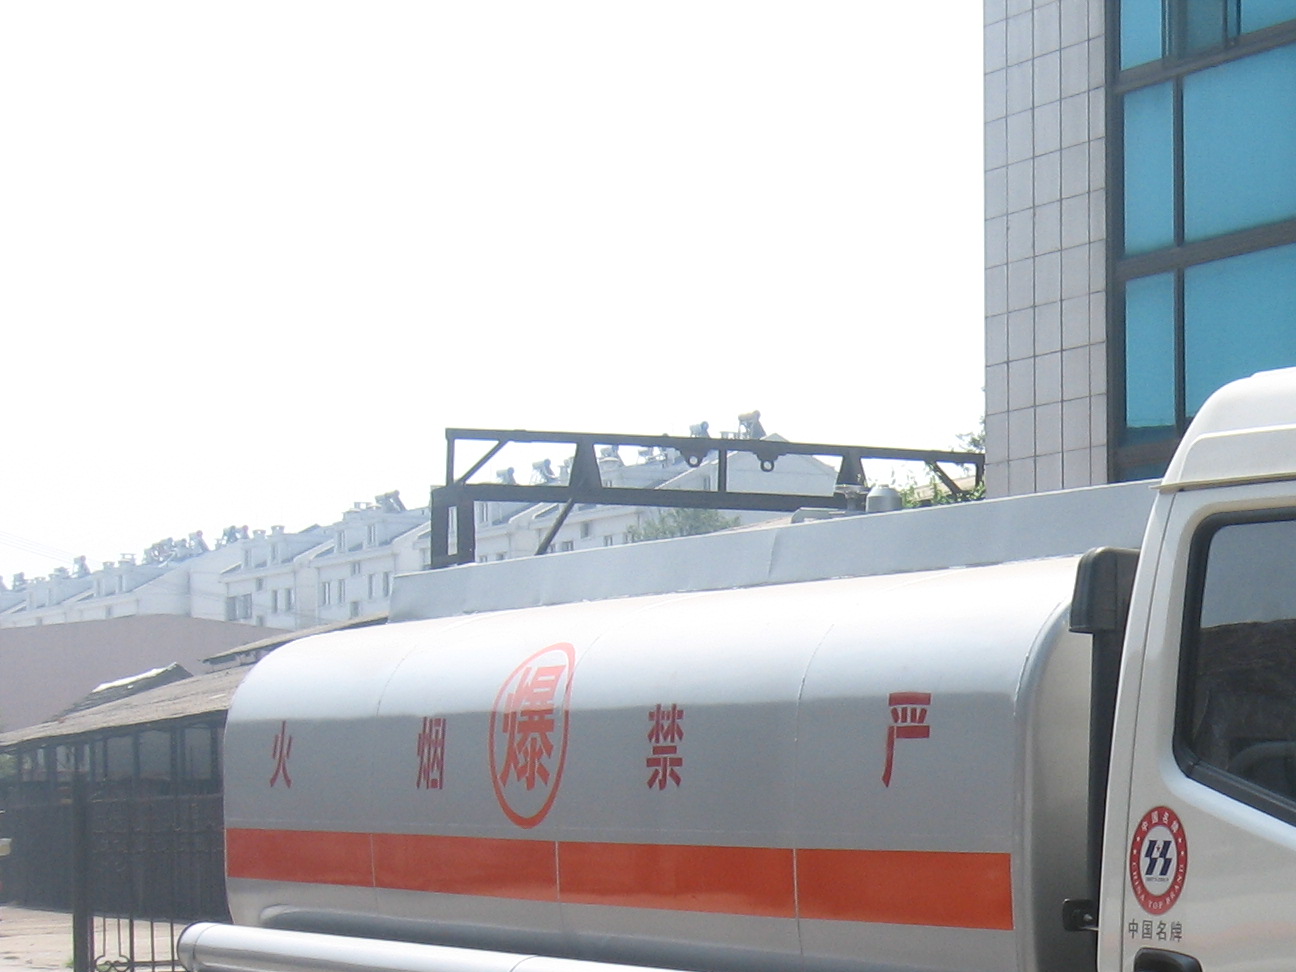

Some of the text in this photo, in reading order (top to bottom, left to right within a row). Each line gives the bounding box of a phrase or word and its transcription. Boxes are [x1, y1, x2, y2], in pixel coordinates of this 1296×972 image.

[269, 691, 932, 791] 火 烟 禁 严
[500, 664, 566, 791] 爆
[1128, 918, 1183, 943] 中国名牌
